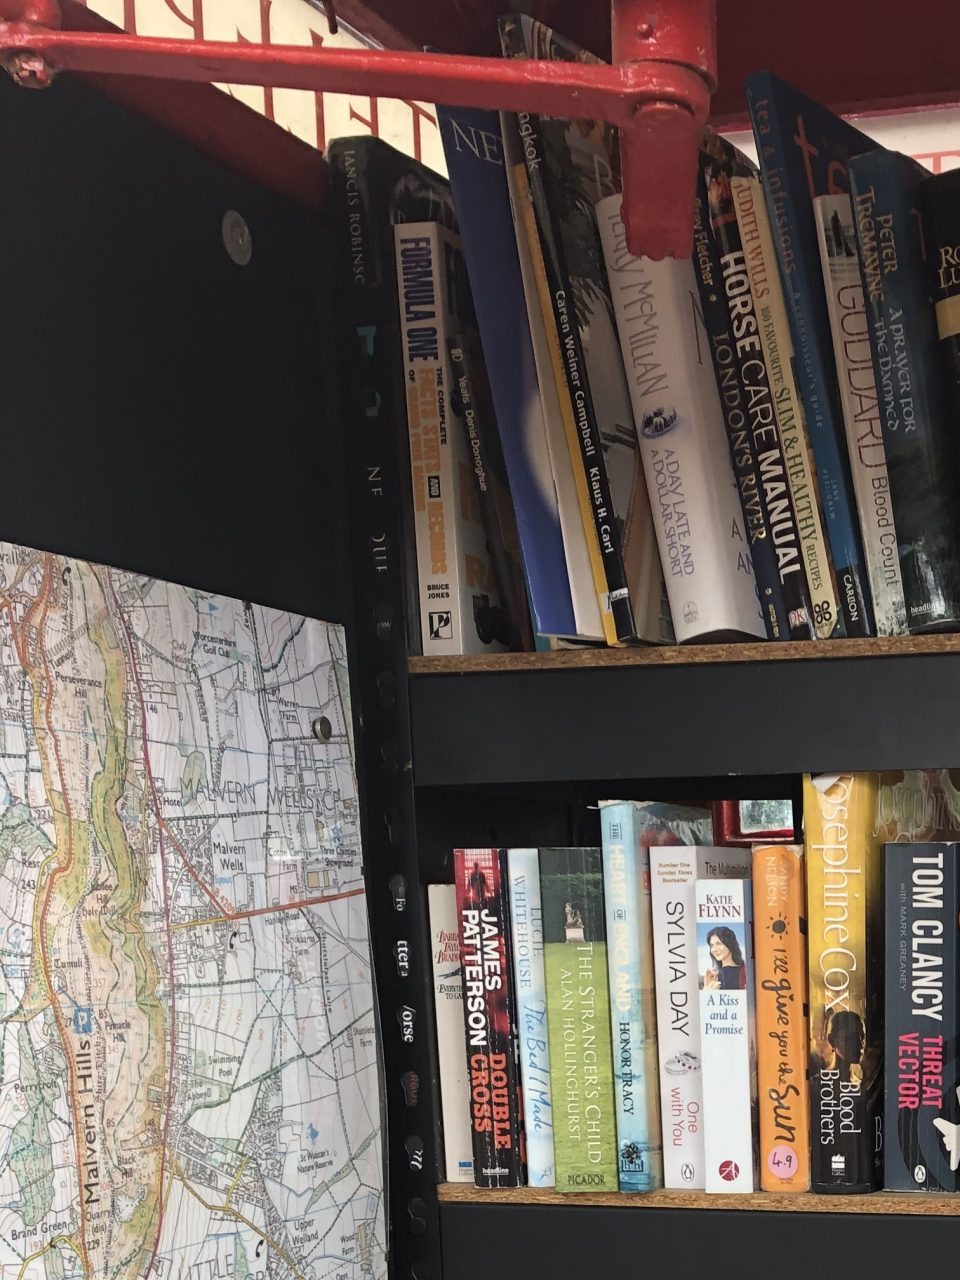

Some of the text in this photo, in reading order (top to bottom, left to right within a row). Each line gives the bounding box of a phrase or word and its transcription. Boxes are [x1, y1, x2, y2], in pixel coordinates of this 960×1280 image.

[400, 237, 436, 314] FORMULA
[406, 315, 439, 362] ONE
[554, 290, 614, 554] Caren Weiner Campbell Klaus Carl
[720, 252, 790, 584] HORSE CARE MANUAL
[842, 574, 859, 622] CARLTON
[55, 674, 103, 688] Perseverance
[74, 688, 87, 698] Hill
[214, 842, 246, 855] Malvern
[220, 858, 244, 872] Wells
[698, 905, 742, 918] FLYNN
[706, 894, 734, 904] KATIE
[480, 909, 502, 991] JAMES
[911, 853, 944, 1021] TOM CLANCY
[462, 910, 488, 1046] PATTERSON
[665, 900, 690, 1036] SYLVIA DAY
[704, 1022, 744, 1037] Promise
[707, 994, 739, 1008] A Kiss
[710, 1009, 728, 1020] and
[560, 967, 581, 1141] ALAN HOLLINGHURST
[577, 944, 602, 1164] THE STRANGER'S CHILD
[898, 1032, 919, 1110] VECTOR
[922, 1035, 943, 1109] THREAT
[76, 1040, 100, 1204] Malvern Hills
[471, 1053, 491, 1133] CROSS
[490, 1054, 512, 1150] DOUBLE
[820, 1068, 840, 1146] Brothers
[568, 1173, 605, 1187] PICADOR
[12, 1222, 68, 1240] Brand Green
[293, 1232, 318, 1245] Welland
[294, 1219, 314, 1230] Upper
